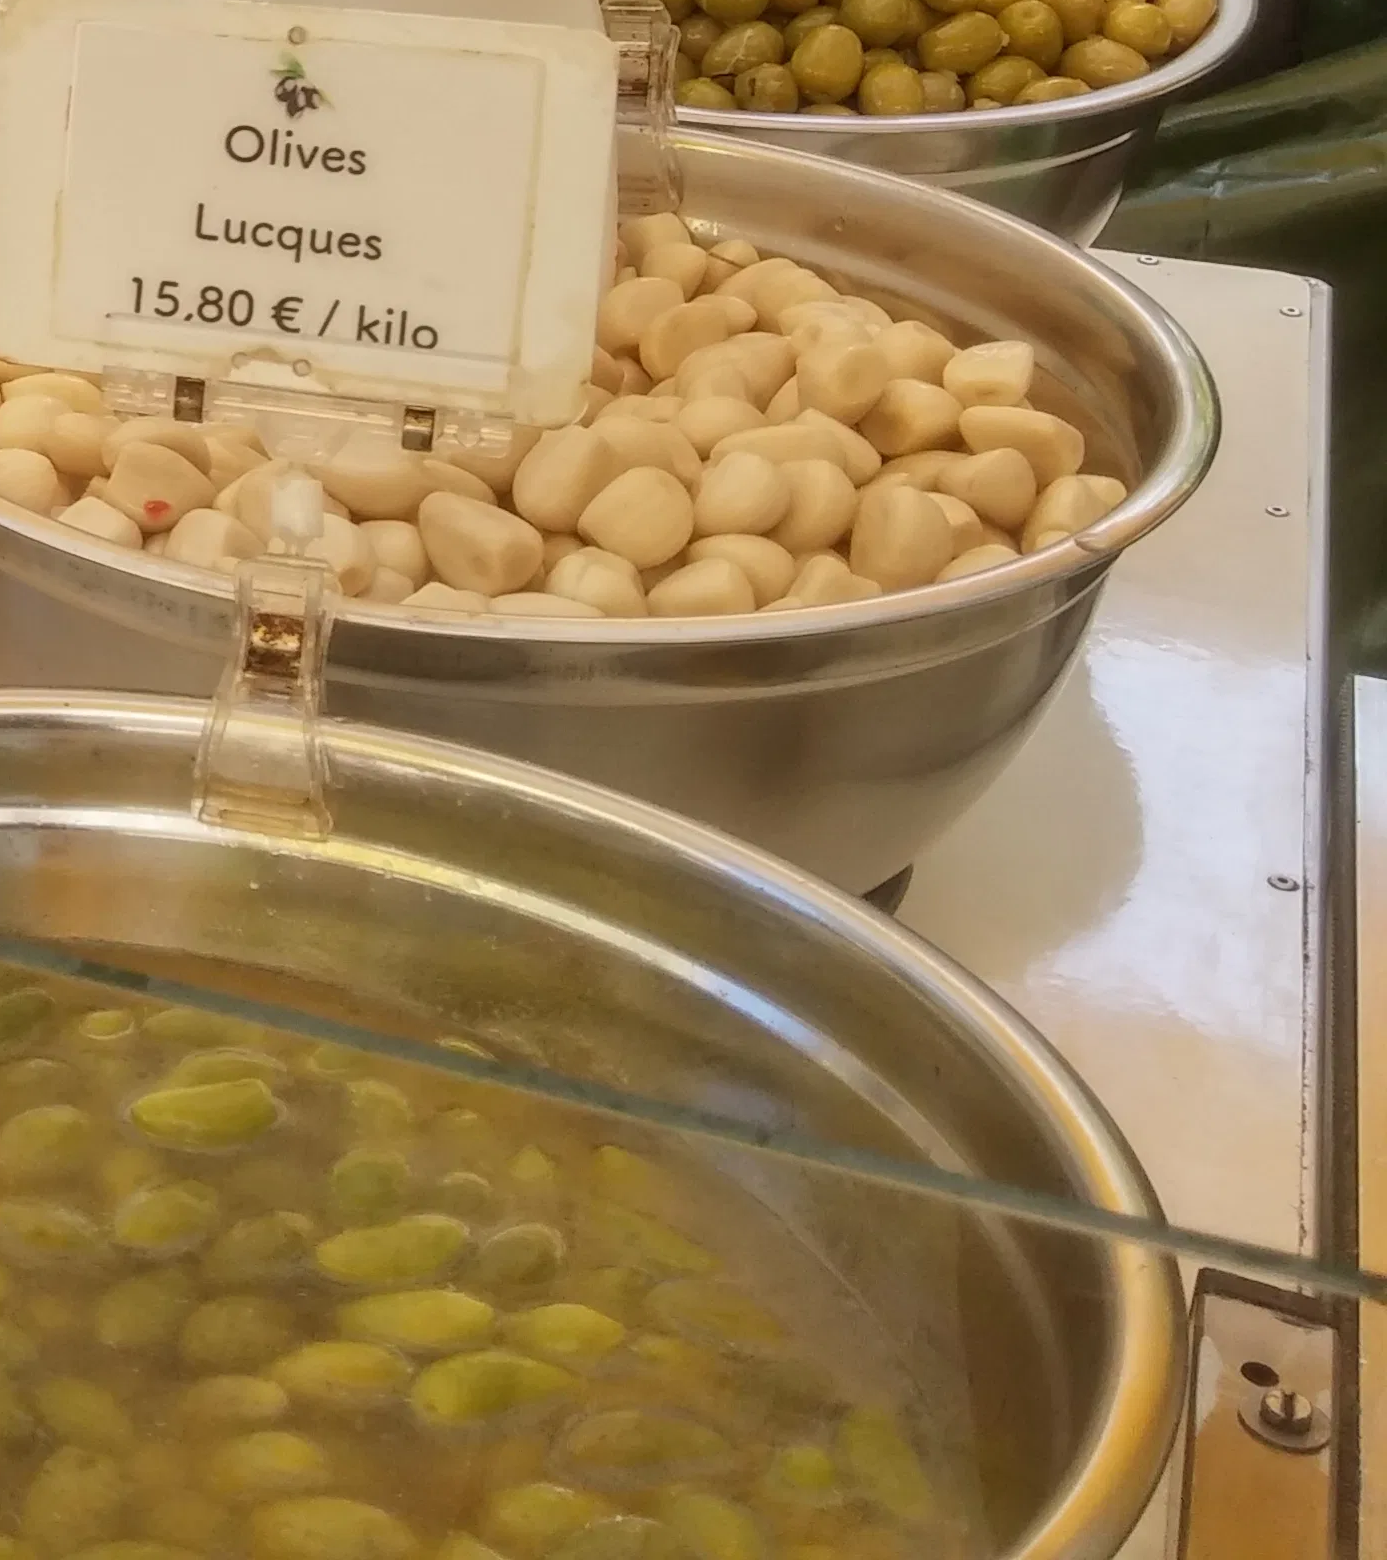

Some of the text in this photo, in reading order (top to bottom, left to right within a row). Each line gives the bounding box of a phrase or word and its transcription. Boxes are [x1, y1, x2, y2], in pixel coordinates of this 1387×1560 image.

[224, 124, 368, 176] Olives
[194, 202, 383, 263] Lucques
[129, 276, 440, 351] 15,80 € / kilo
